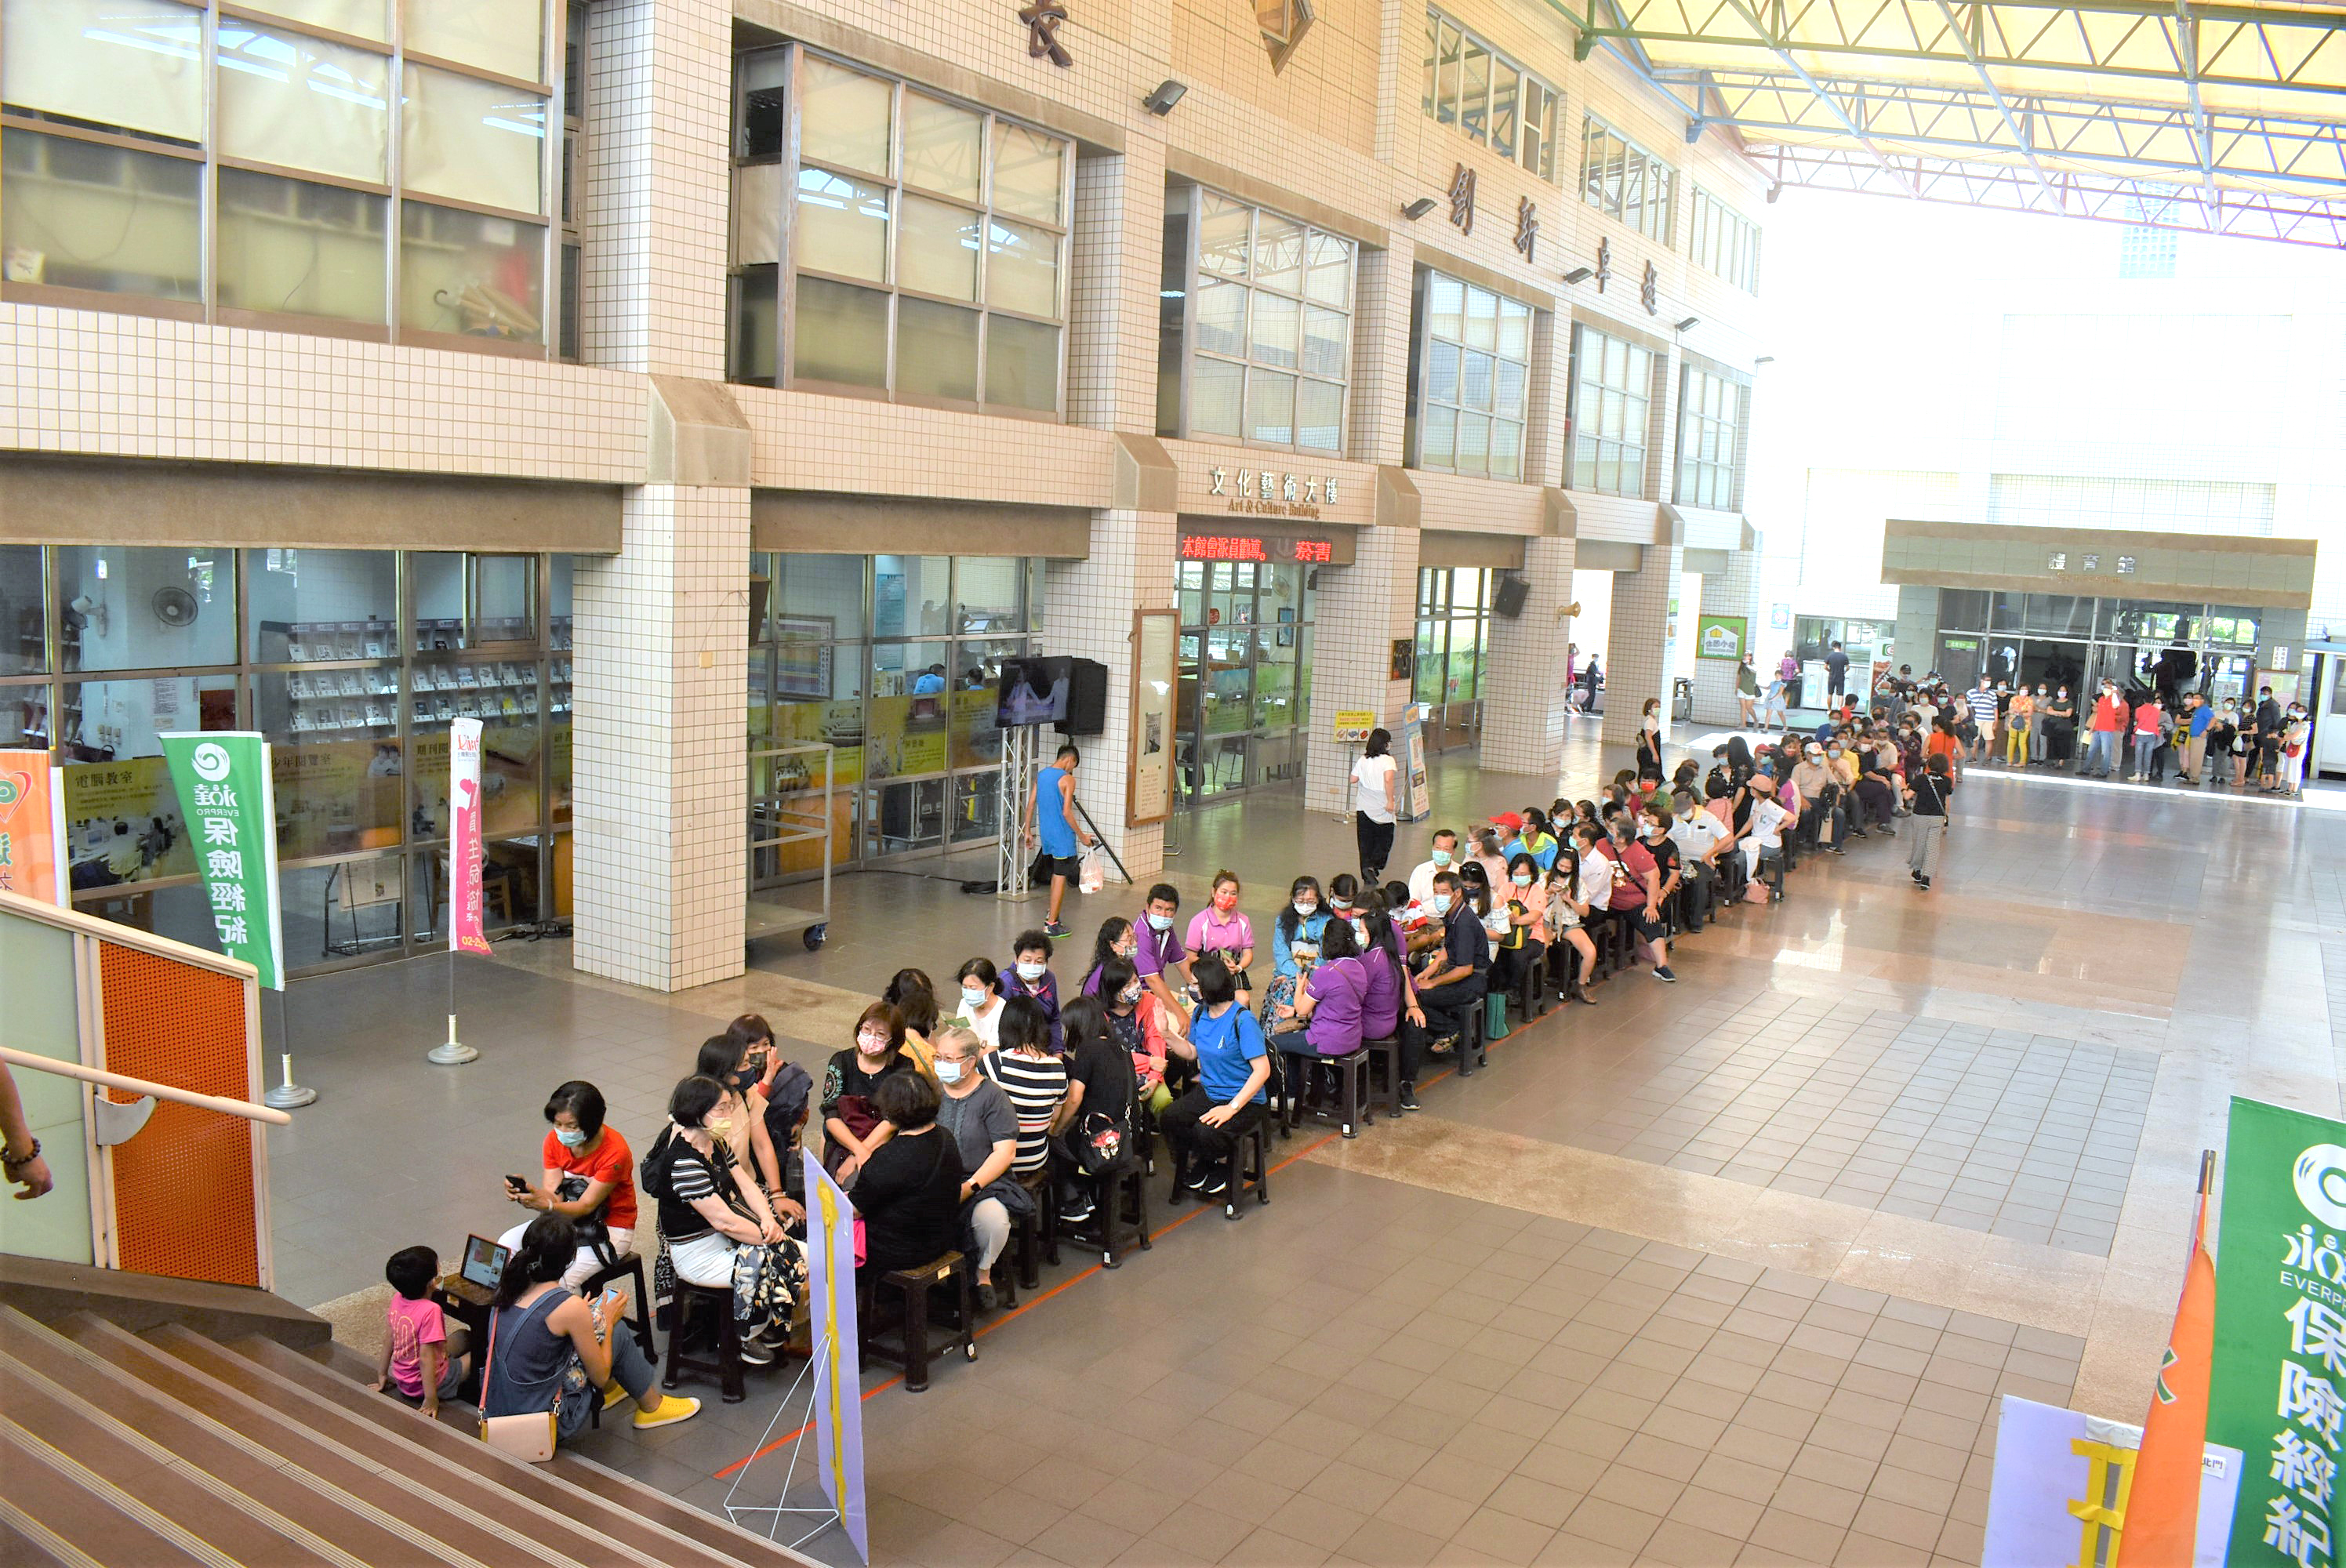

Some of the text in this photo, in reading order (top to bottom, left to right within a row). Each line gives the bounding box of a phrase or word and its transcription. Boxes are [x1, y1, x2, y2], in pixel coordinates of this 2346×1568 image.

[1210, 466, 1338, 504] 文化藝術大樓
[1229, 499, 1320, 520] Art & Culture Building
[2048, 552, 2135, 573] 體育館
[75, 771, 133, 789] 電腦教室
